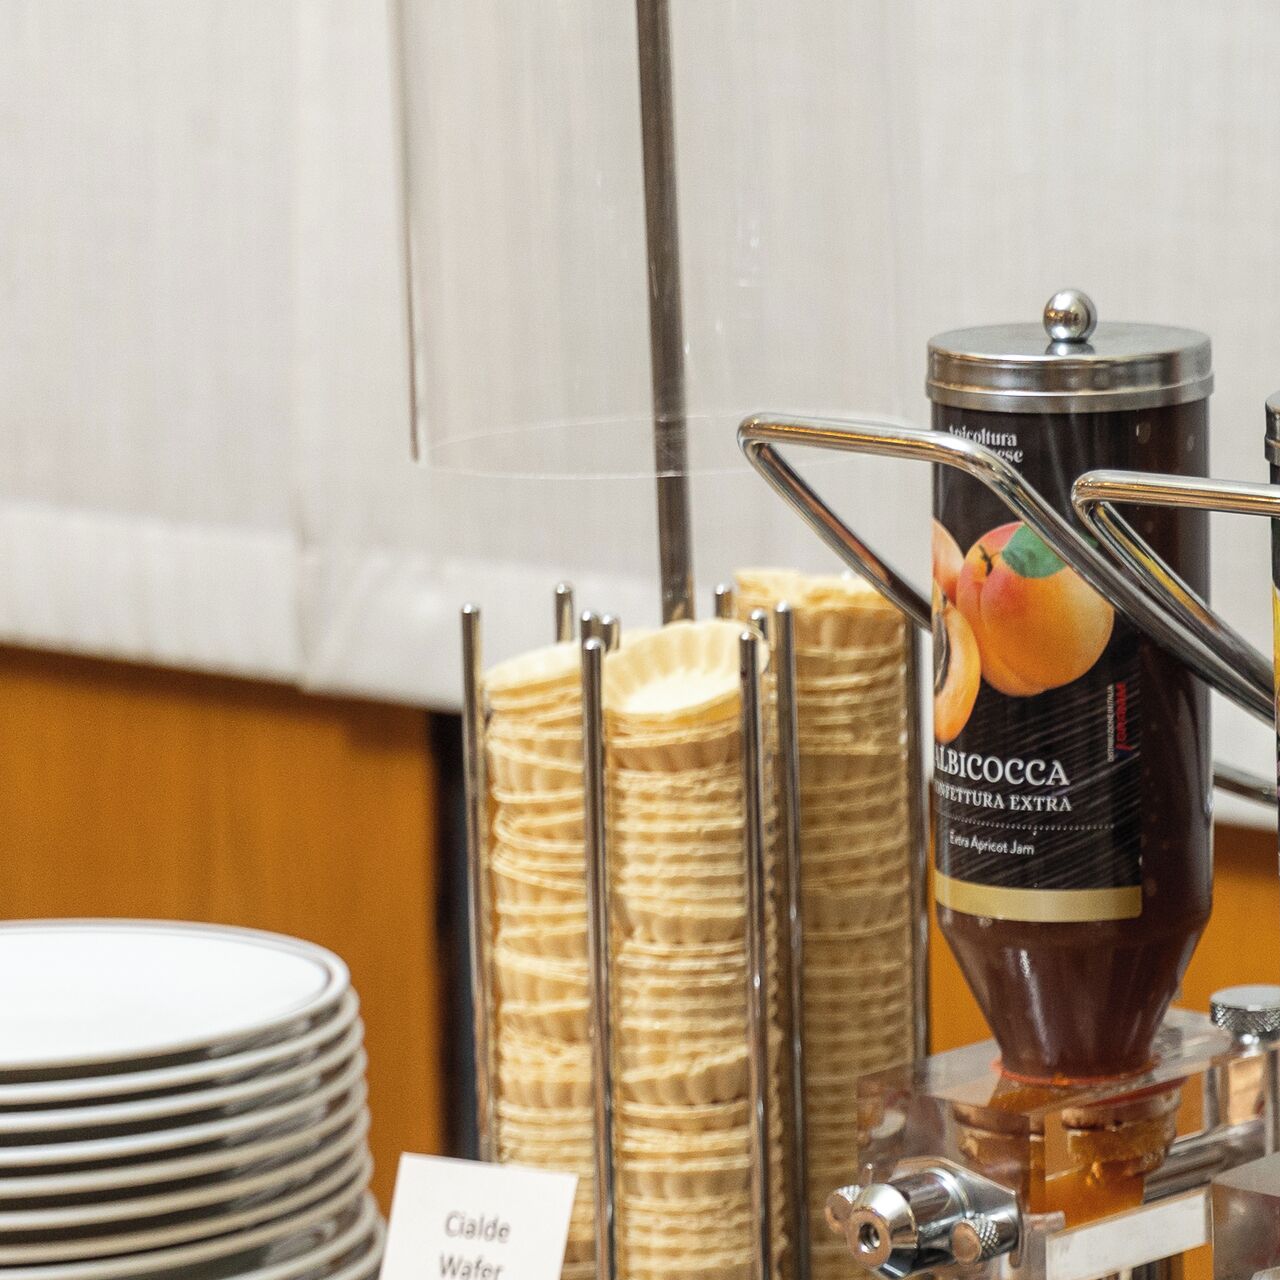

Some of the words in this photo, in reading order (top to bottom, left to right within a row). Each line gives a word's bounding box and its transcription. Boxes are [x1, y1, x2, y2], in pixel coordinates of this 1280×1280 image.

[1009, 794, 1072, 812] EXTRA
[970, 835, 1008, 854] Apricot
[1010, 840, 1035, 855] Jam
[444, 1210, 512, 1244] Cialde
